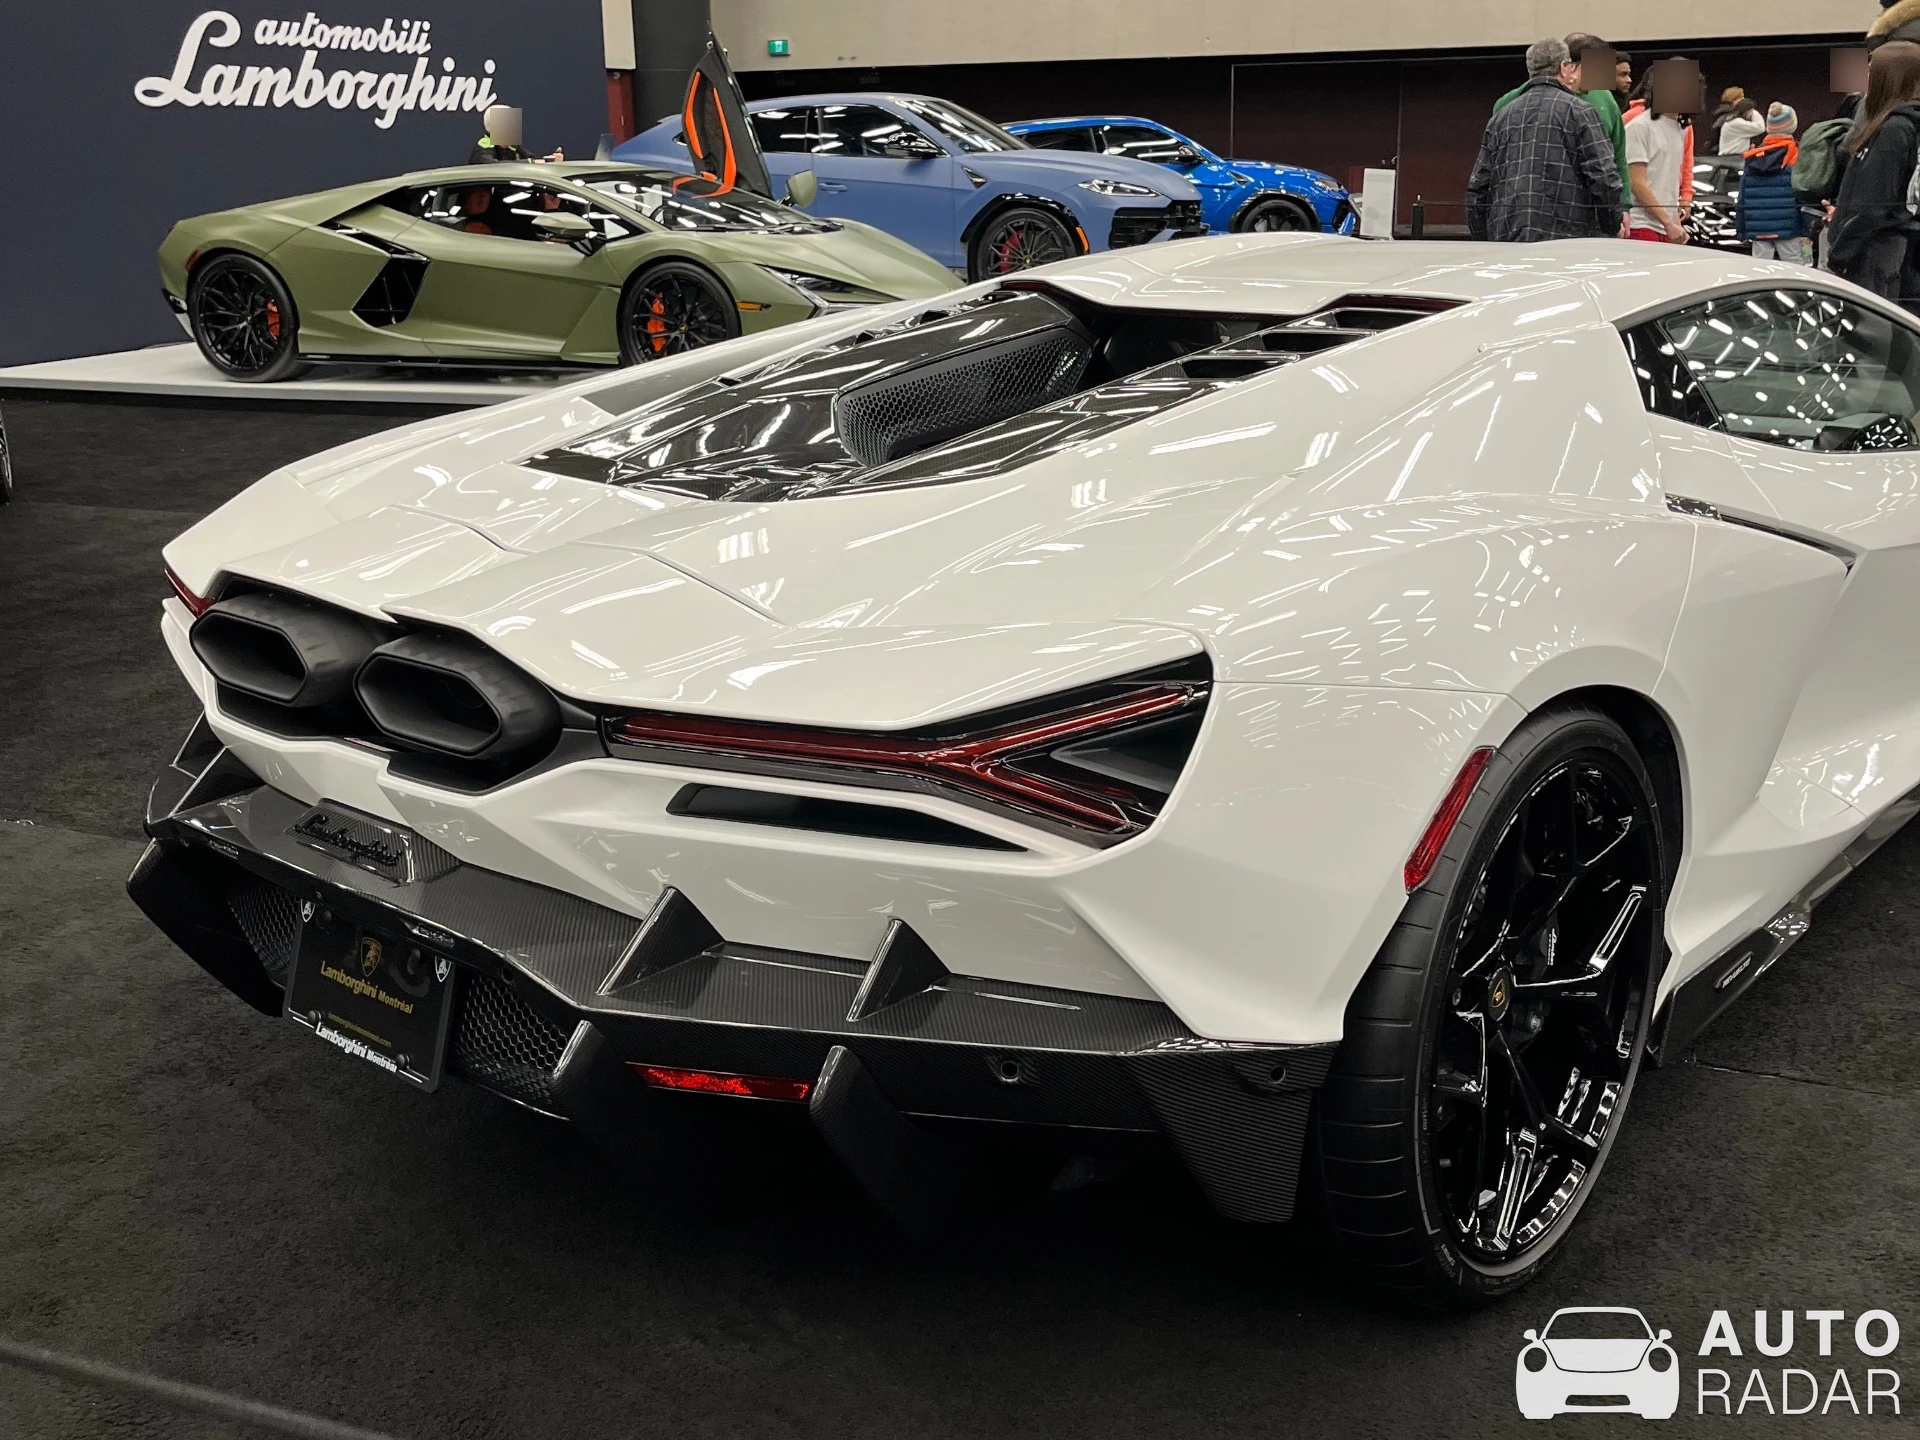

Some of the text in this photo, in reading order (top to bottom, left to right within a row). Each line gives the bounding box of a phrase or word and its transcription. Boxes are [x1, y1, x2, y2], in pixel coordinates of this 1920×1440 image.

[254, 12, 432, 55] automobili
[134, 10, 498, 129] Lamborghini
[320, 960, 414, 1014] Lamborghini Montréal
[315, 1021, 367, 1059] Lamborghini
